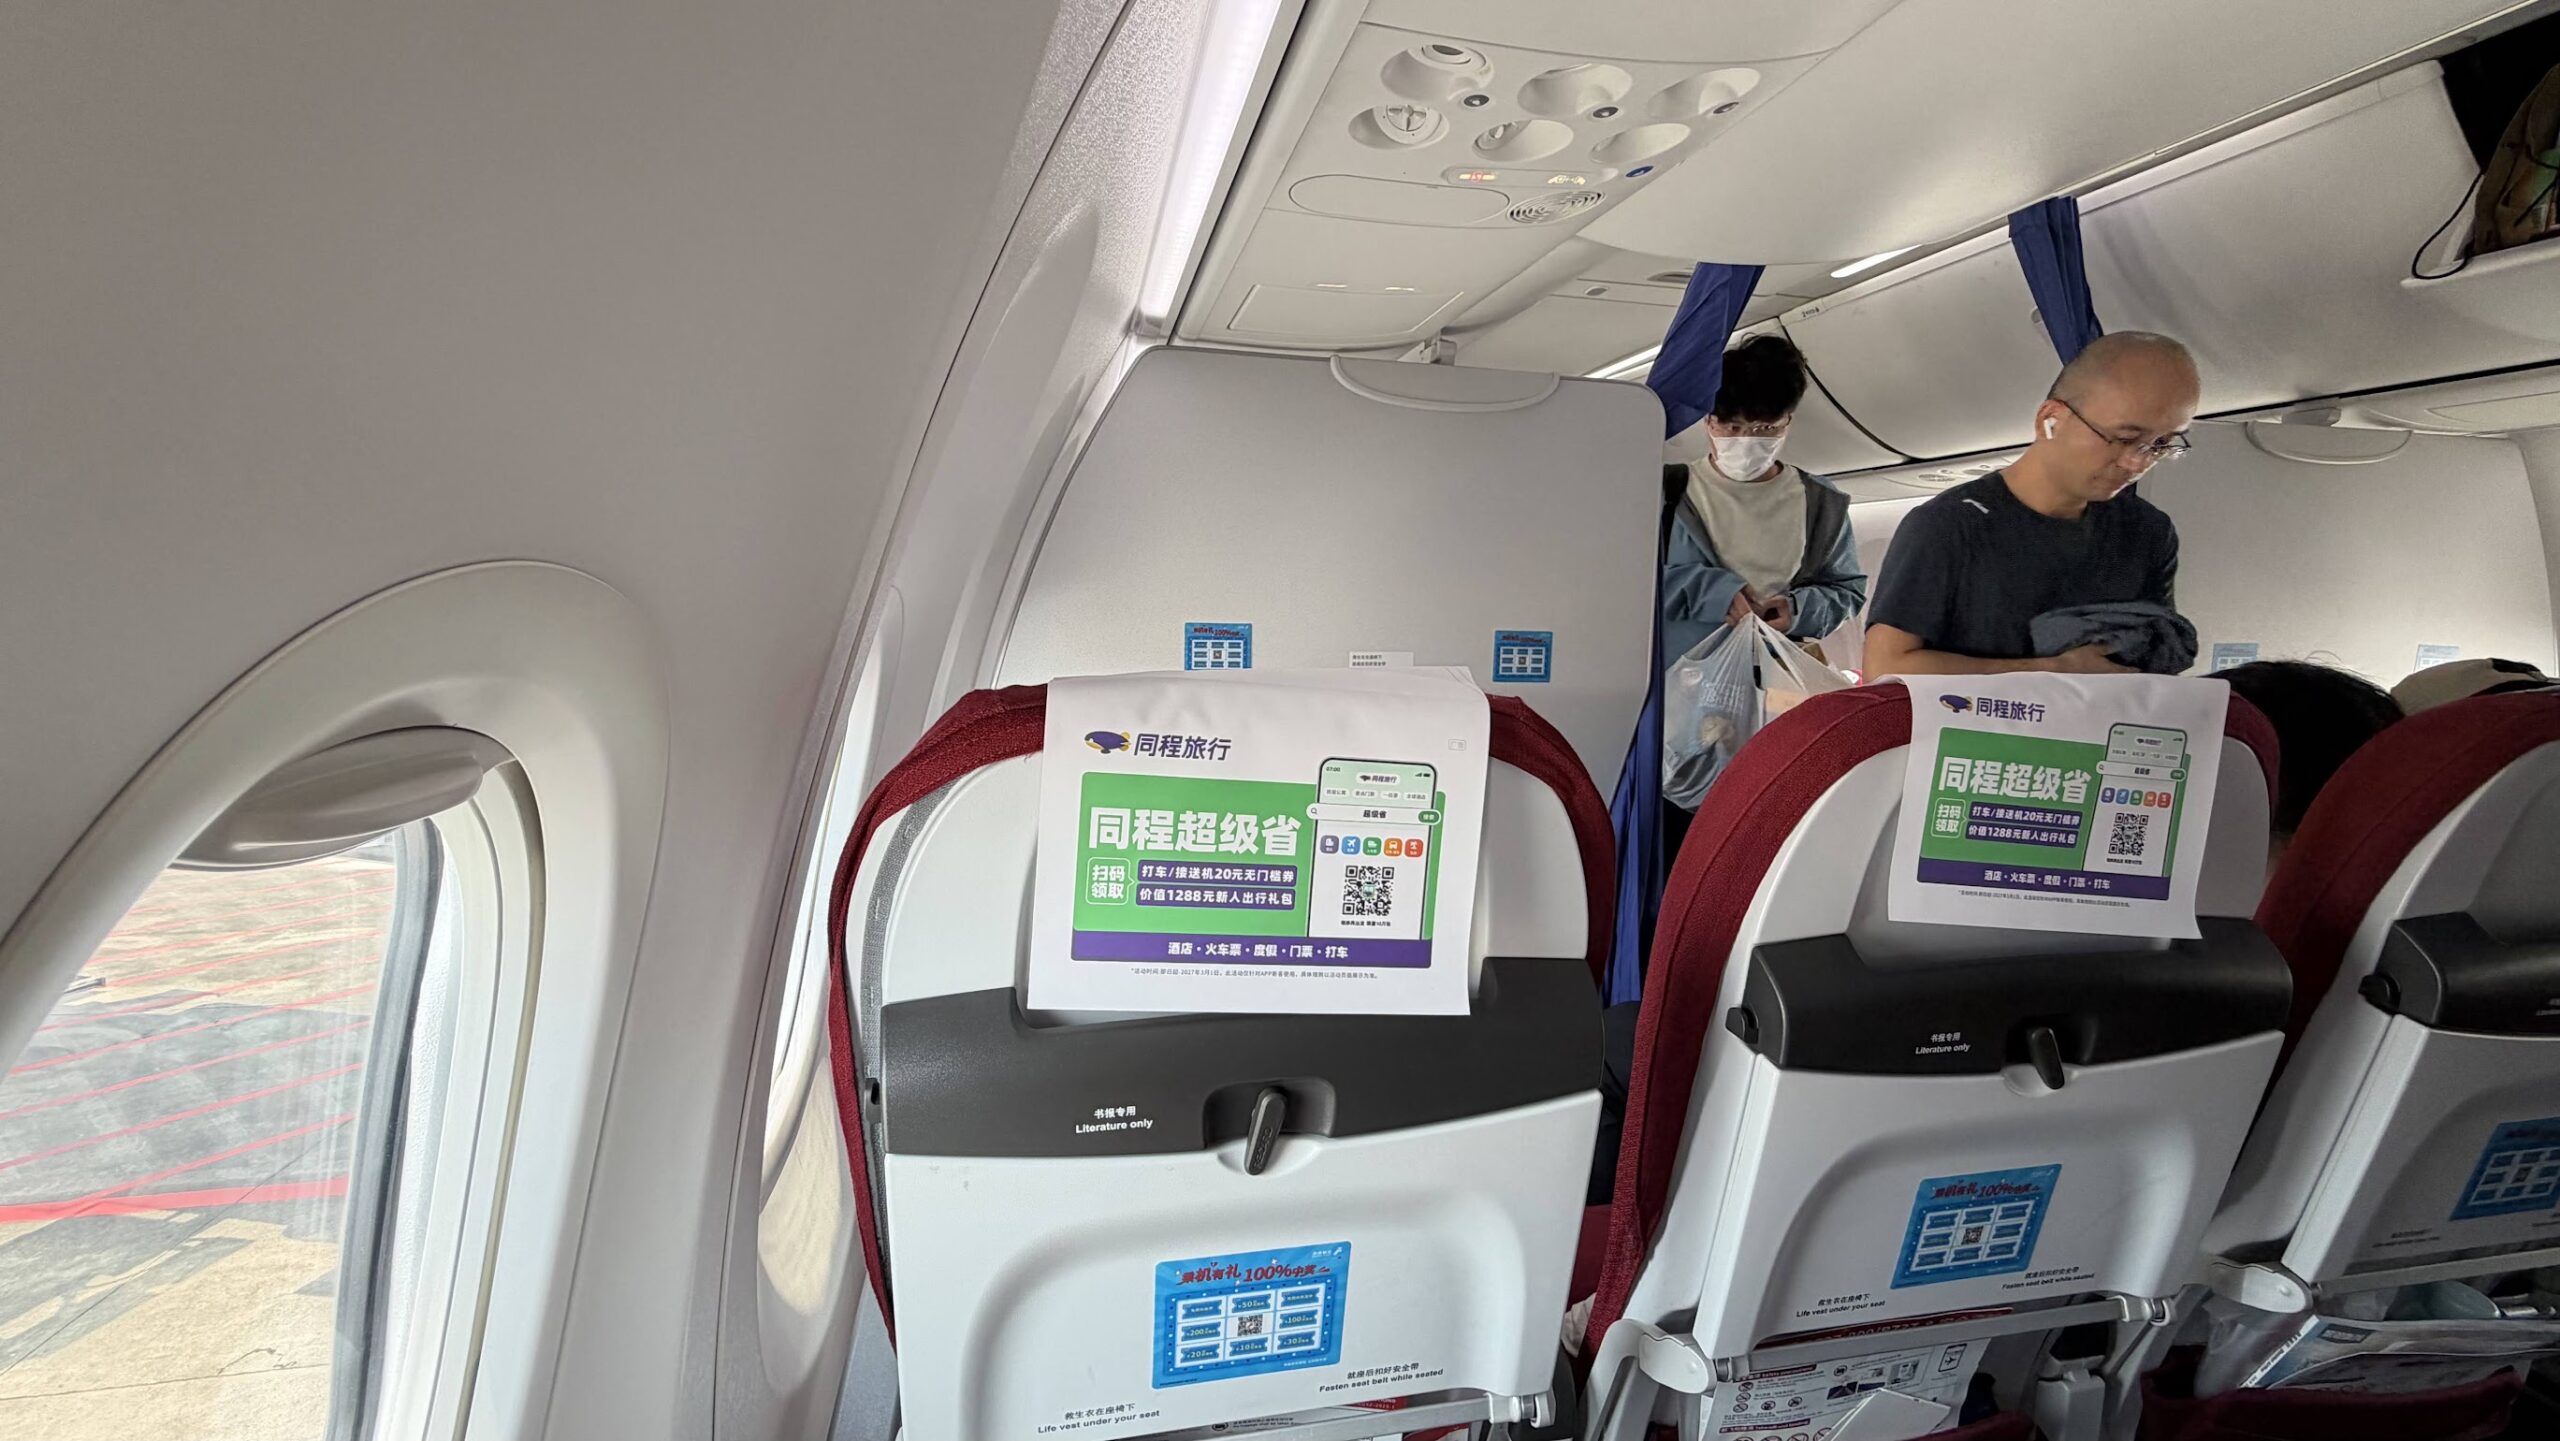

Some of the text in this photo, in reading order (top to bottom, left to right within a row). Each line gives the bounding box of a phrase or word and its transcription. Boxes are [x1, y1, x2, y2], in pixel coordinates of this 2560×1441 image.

[1976, 697, 2046, 722] 同程旅行
[1133, 733, 1232, 761] 同程旅行
[1938, 756, 2092, 804] 同程超级省
[1363, 809, 1387, 818] 超级省
[1938, 804, 1960, 819] 扫码
[1088, 806, 1301, 857] 同程超级省
[1935, 819, 1959, 834] 领取
[1969, 825, 2077, 845] 价值1288元新人出行礼包
[1092, 864, 1125, 882] 扫码
[1142, 864, 1294, 884] 打车/接送机20元无门槛券
[1091, 882, 1124, 899] 领取
[1139, 887, 1293, 907] 价值1288元新人出行礼包
[1915, 1043, 1971, 1055] Literature only
[1094, 1106, 1136, 1119] 书报专用
[1075, 1118, 1153, 1133] Literature only
[1243, 1264, 1317, 1282] 100%中奖
[1796, 1309, 1810, 1317] Life
[1812, 1307, 1827, 1315] vest
[1829, 1305, 1850, 1313] under
[1852, 1302, 1869, 1311] your
[1319, 1368, 1444, 1392] Fasten seat belt while seated
[1065, 1403, 1136, 1420] 救生衣在座椅下
[1038, 1410, 1160, 1434] Life vest under your seat
